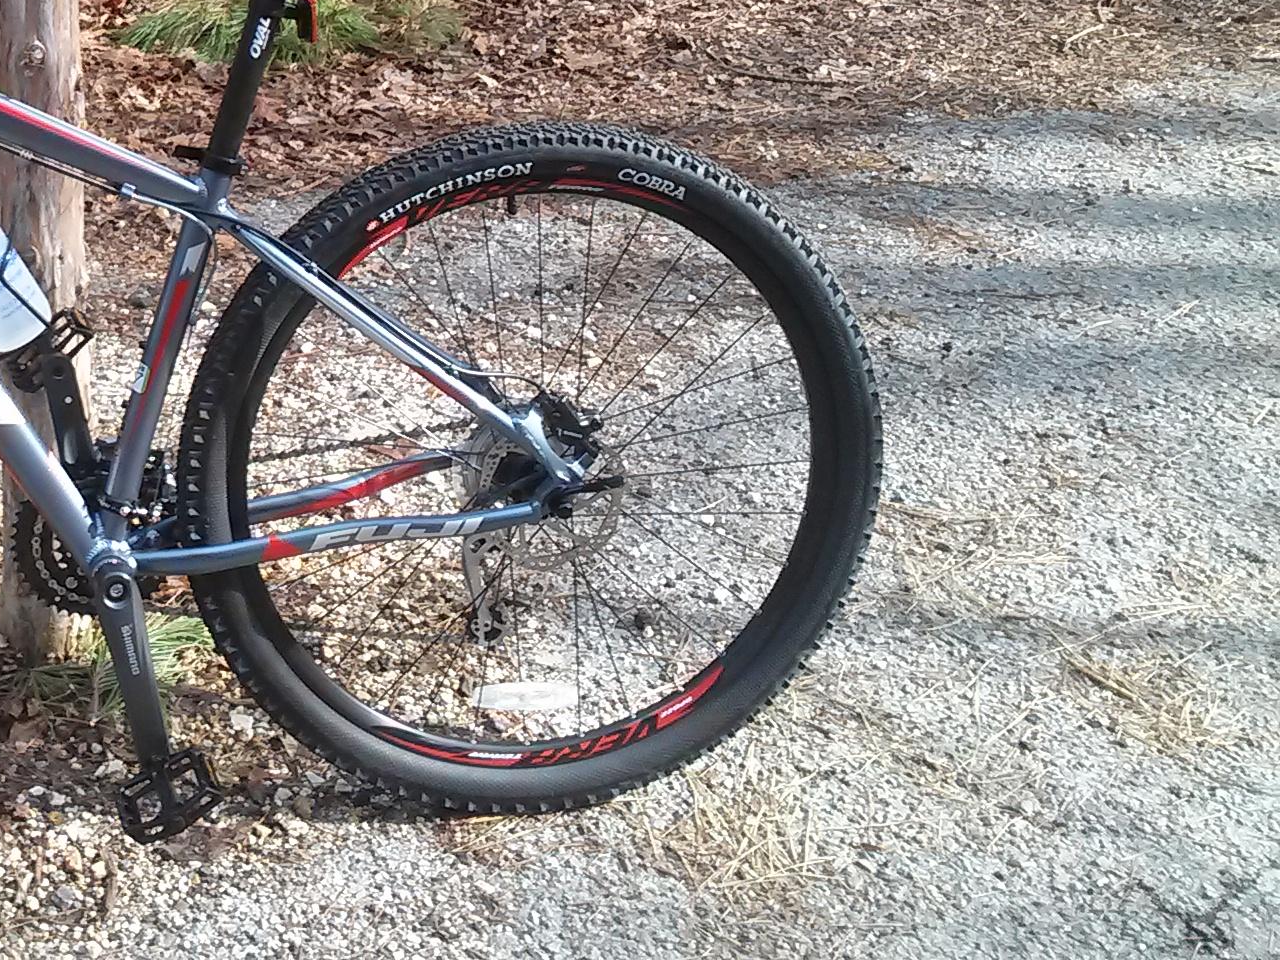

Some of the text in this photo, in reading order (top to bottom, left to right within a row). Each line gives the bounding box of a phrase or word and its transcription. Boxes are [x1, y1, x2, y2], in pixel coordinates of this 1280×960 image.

[249, 16, 271, 60] OVAL
[379, 161, 687, 225] HUTCHINSON COBRA
[309, 516, 484, 552] FUJI
